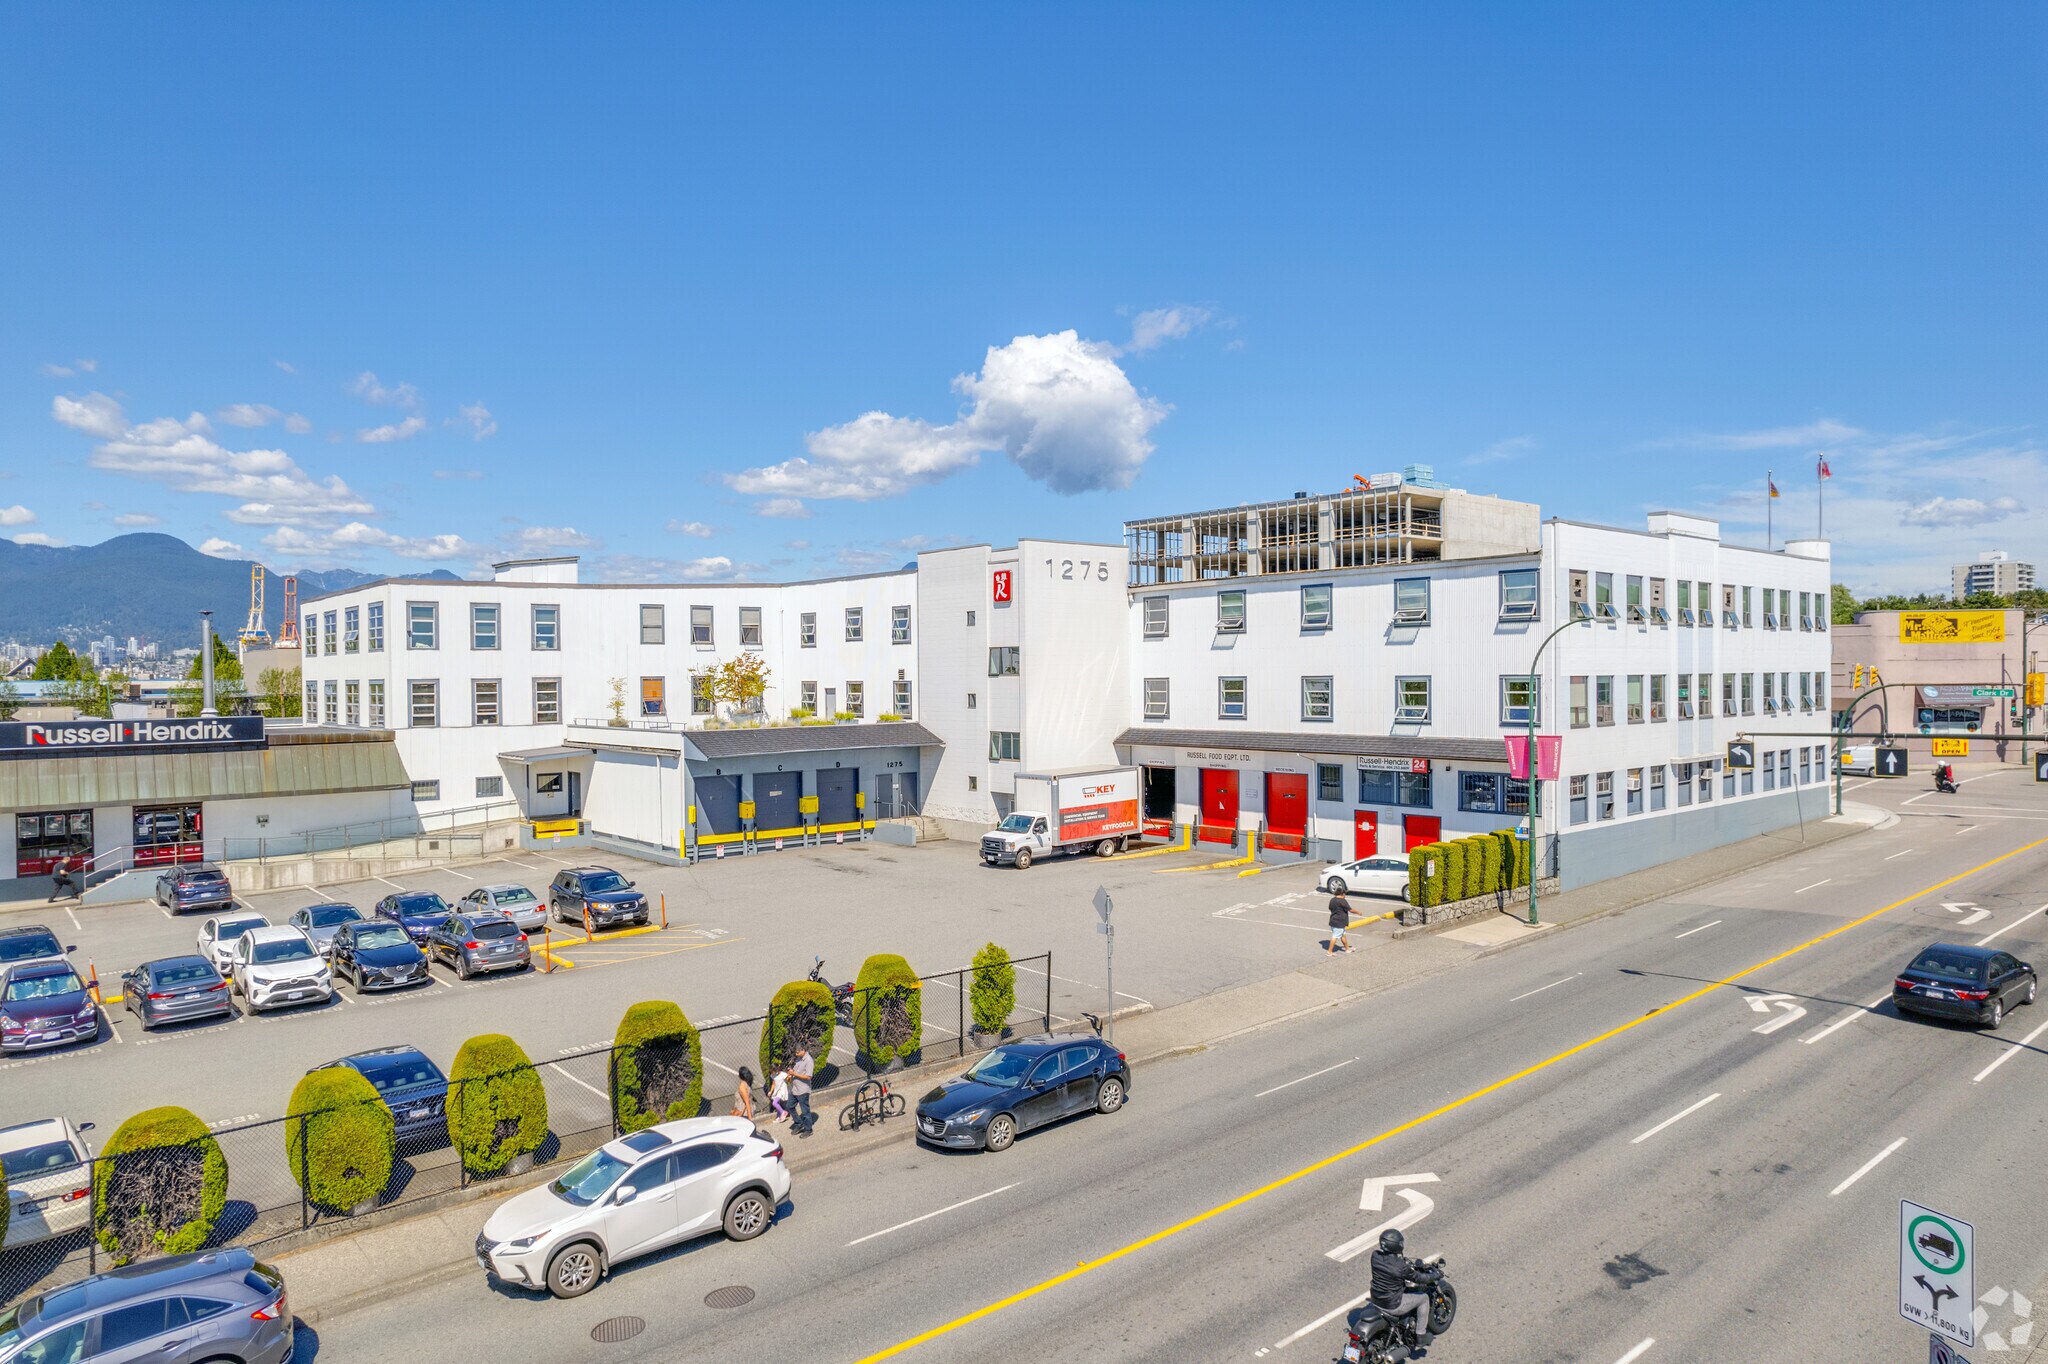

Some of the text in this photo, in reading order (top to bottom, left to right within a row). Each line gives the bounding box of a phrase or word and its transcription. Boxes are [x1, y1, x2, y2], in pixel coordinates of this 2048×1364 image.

[1045, 559, 1109, 582] 1275
[1187, 751, 1207, 759] RUSSELL
[1209, 752, 1222, 760] FOOD
[1413, 759, 1425, 769] 24
[716, 768, 721, 776] B
[1096, 784, 1115, 794] KEY
[1102, 821, 1134, 831] KEYFOOD.CA
[367, 990, 443, 1006] RESERVED
[136, 1026, 230, 1046] RESERVED
[1904, 1303, 1921, 1317] GVW
[1931, 1315, 1956, 1332] 11,800
[1959, 1326, 1969, 1341] kg
